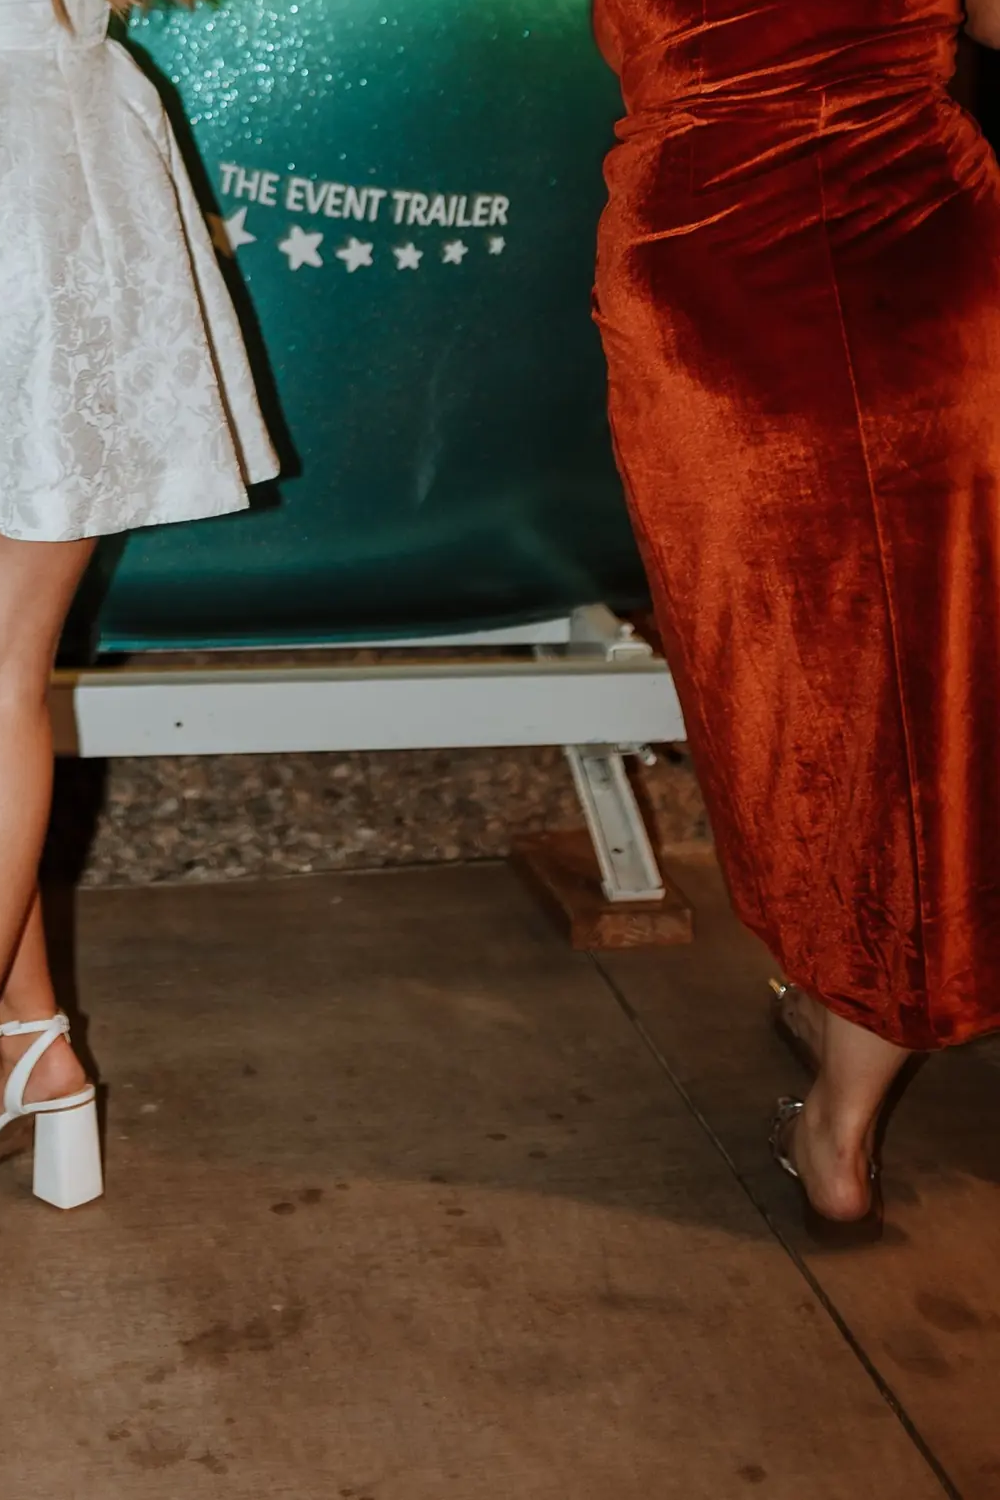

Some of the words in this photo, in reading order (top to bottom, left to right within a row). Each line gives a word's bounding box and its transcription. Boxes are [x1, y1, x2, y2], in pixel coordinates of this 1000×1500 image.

[219, 163, 280, 207] THE
[285, 177, 387, 223] EVENT
[392, 190, 511, 228] TRAILER
